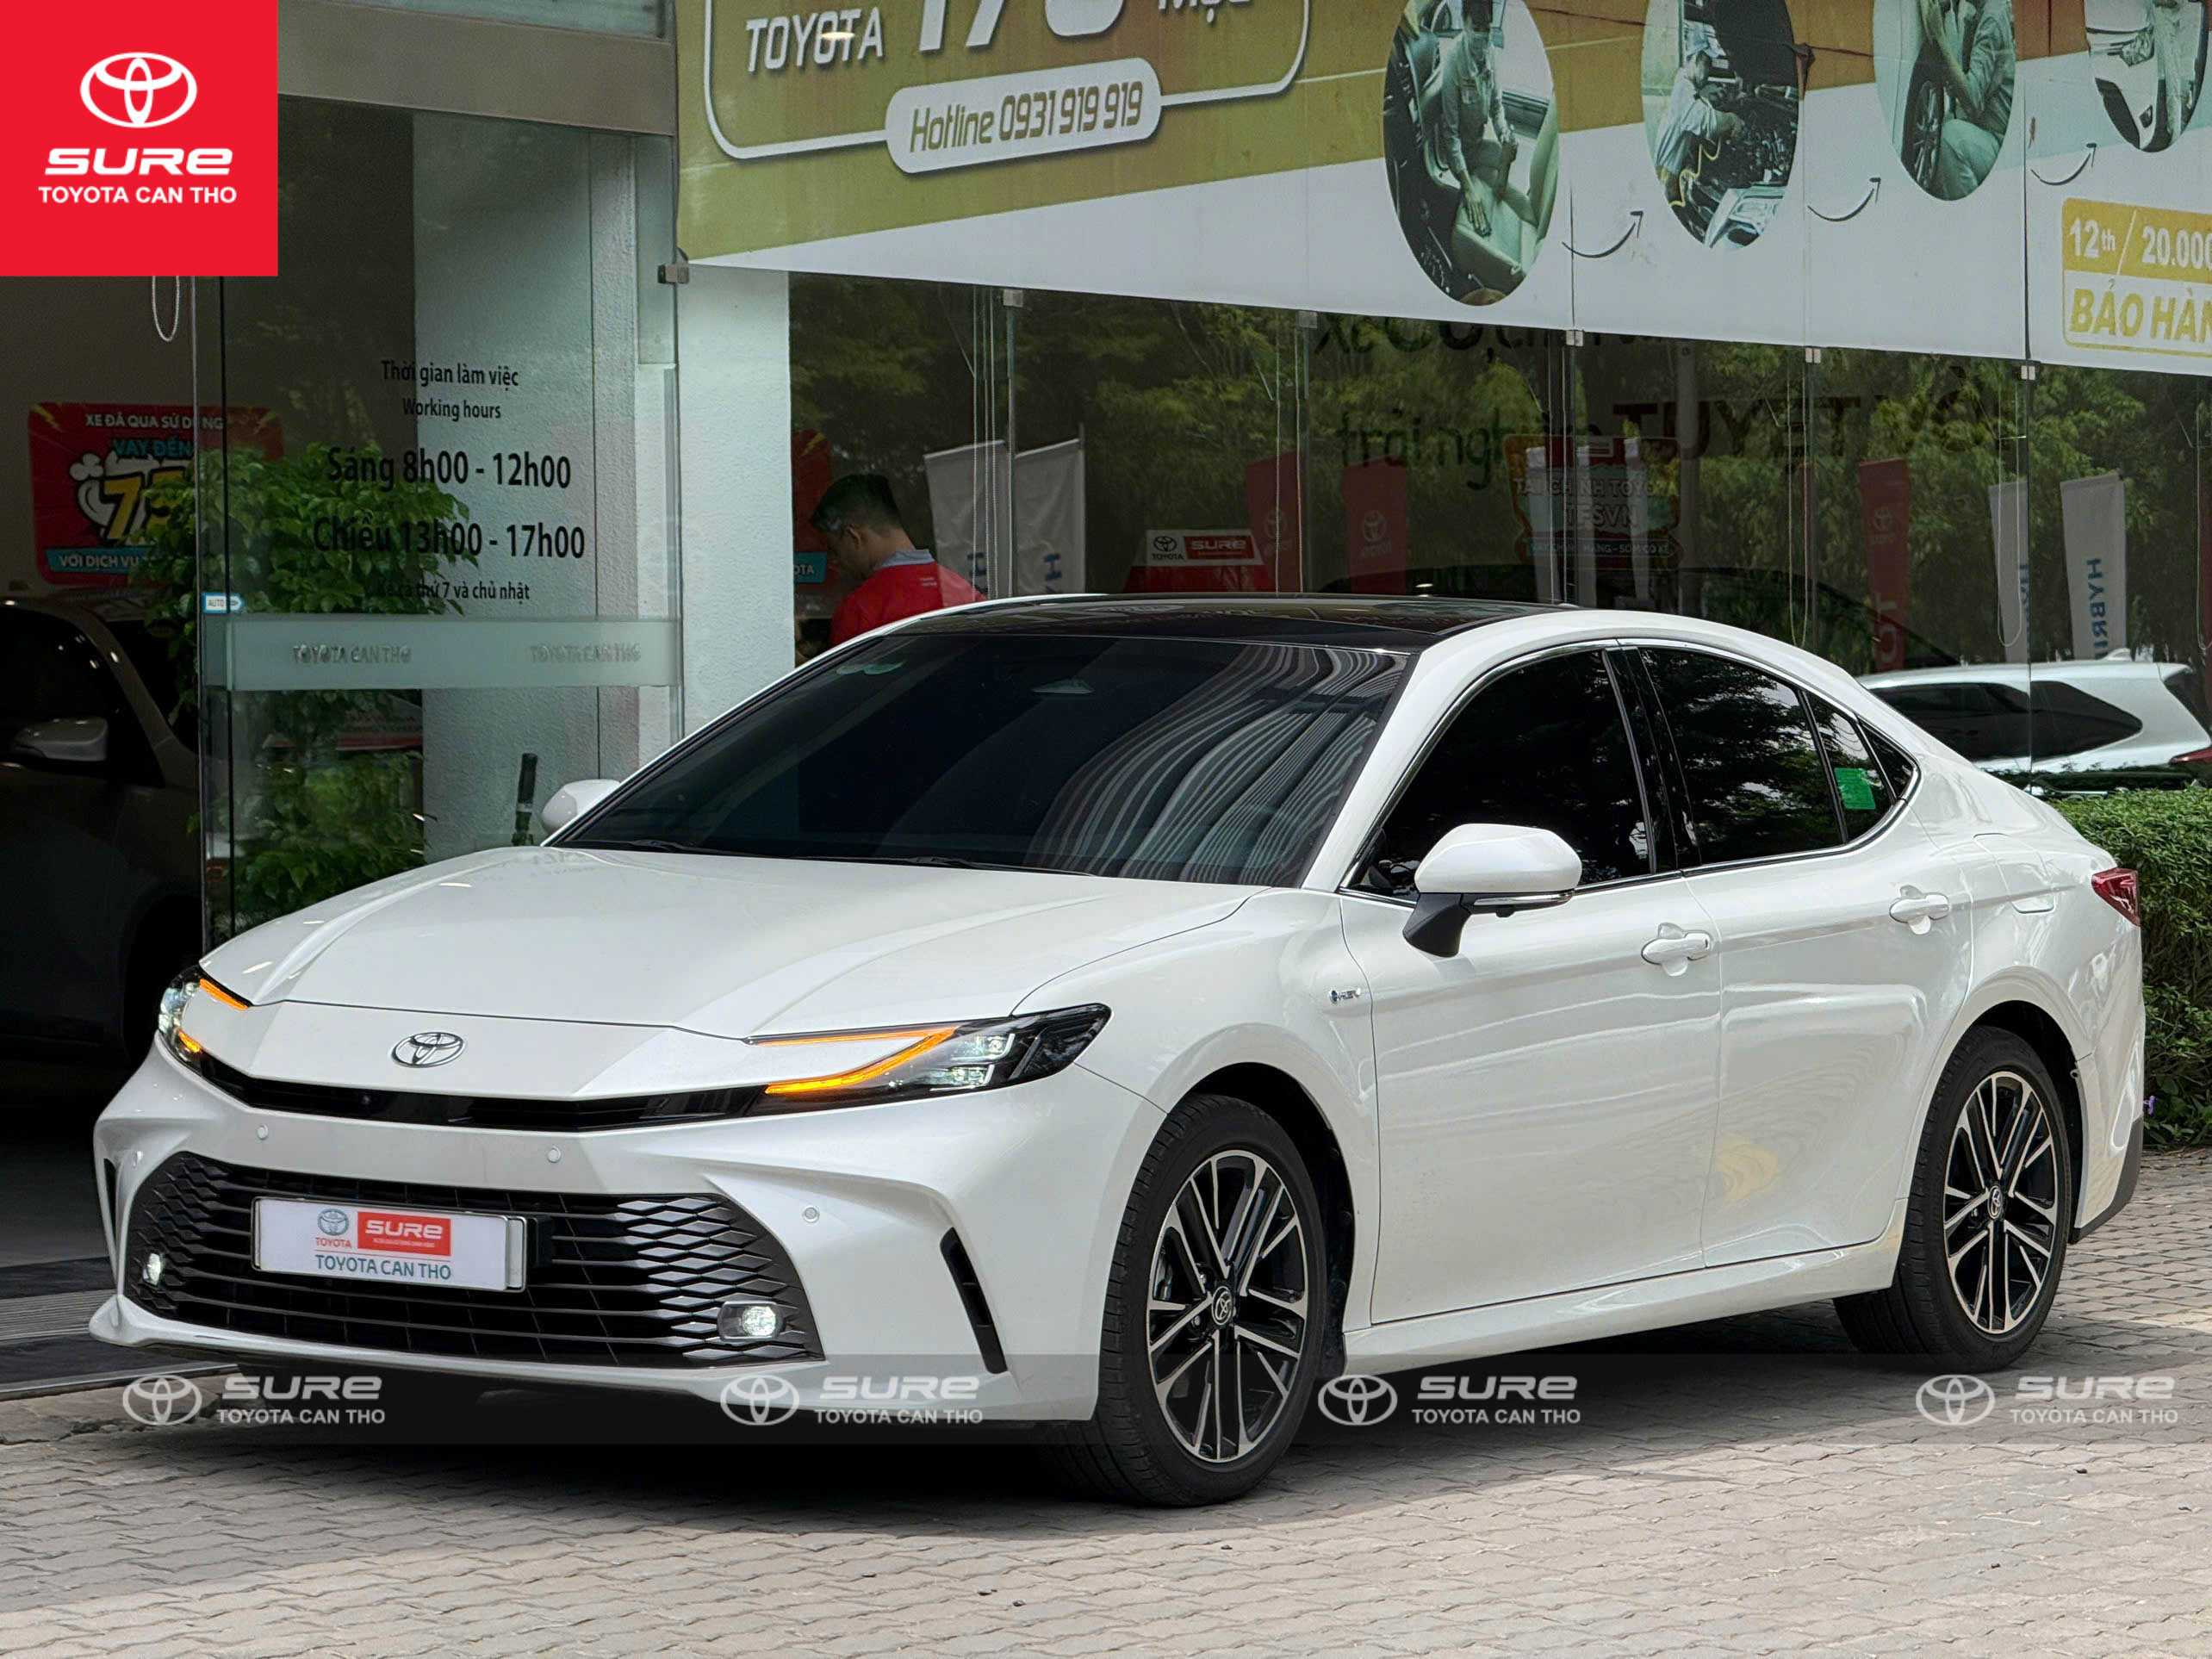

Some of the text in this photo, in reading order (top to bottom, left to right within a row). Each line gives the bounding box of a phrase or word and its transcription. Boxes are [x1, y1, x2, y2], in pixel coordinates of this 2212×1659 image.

[746, 7, 884, 71] TOYOTA
[910, 81, 1143, 152] Hotline 0931 919 919
[2069, 278, 2144, 338] BẢO
[381, 360, 519, 391] Thời gian làm việc
[401, 397, 501, 421] Working hours
[87, 414, 103, 427] XE
[127, 414, 159, 429] QUA
[182, 416, 226, 431] DNG
[112, 438, 150, 457] VAY
[326, 446, 395, 492] Sáng
[402, 448, 469, 484] 8h00
[493, 451, 571, 488] 12h00
[313, 510, 395, 552] Chiều
[401, 519, 482, 556] 13h00
[506, 522, 586, 558] 17h00
[442, 582, 450, 598] 7
[455, 582, 469, 600] và
[472, 581, 496, 600] chủ
[500, 582, 530, 605] nhật
[291, 644, 345, 662] TOYOTA
[350, 644, 380, 662] CAN
[315, 1237, 352, 1249] TOYOTA
[314, 1254, 451, 1280] TOYOTA CAN THO
